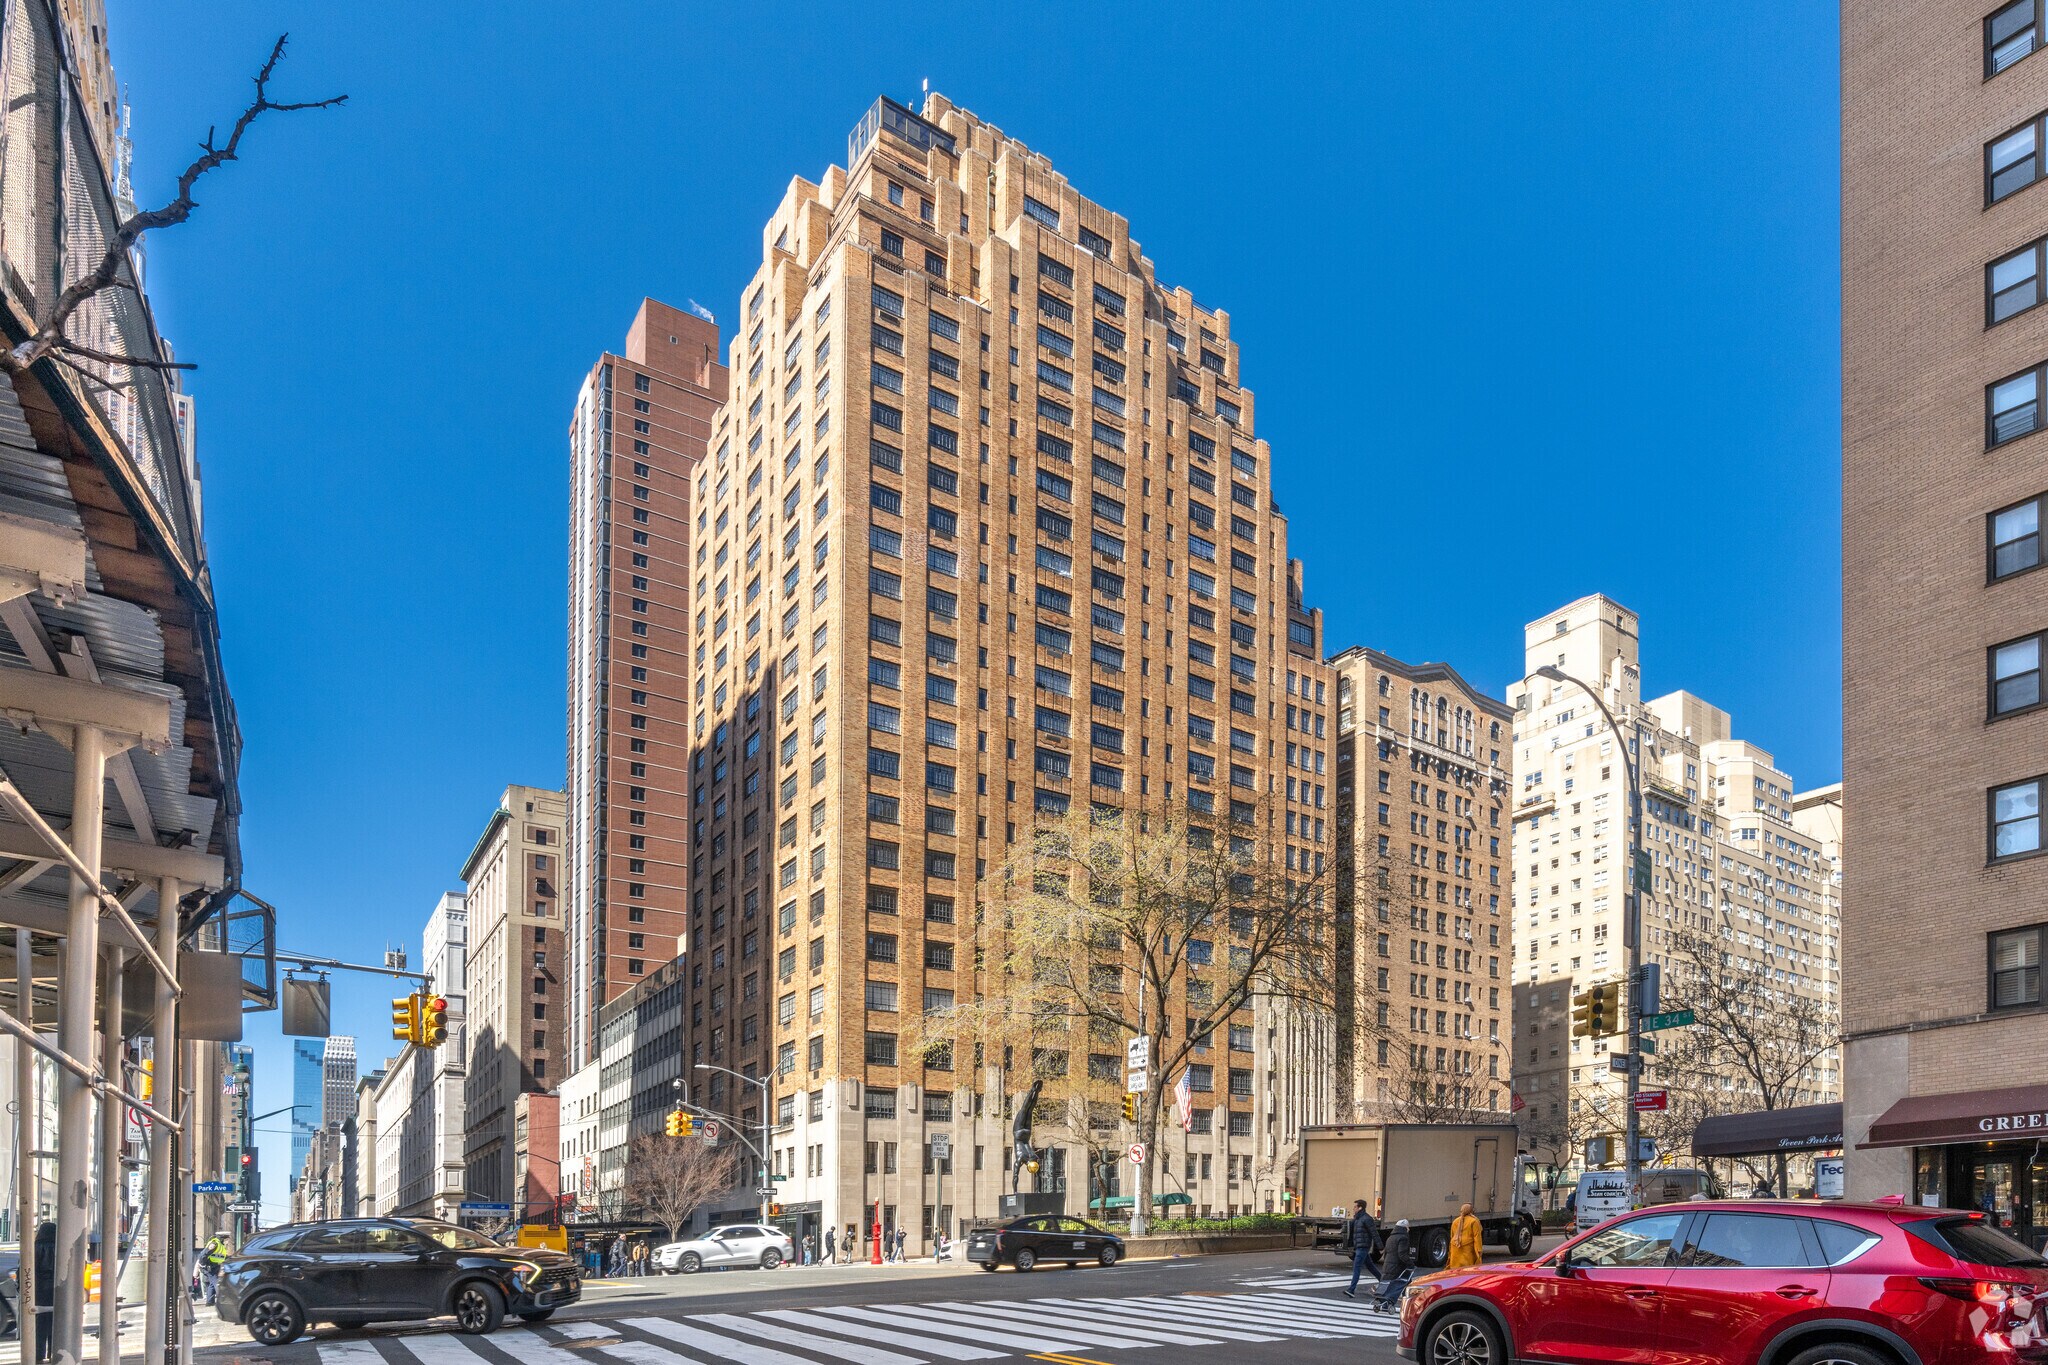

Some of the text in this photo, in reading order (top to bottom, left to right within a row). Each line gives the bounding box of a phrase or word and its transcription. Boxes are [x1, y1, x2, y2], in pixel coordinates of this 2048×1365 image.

[1652, 1017, 1659, 1028] E
[1664, 1013, 1680, 1026] 34
[1615, 1059, 1625, 1068] ONE
[1979, 1113, 2048, 1131] GREE
[1778, 1138, 1804, 1147] Seven
[1806, 1134, 1829, 1144] Park
